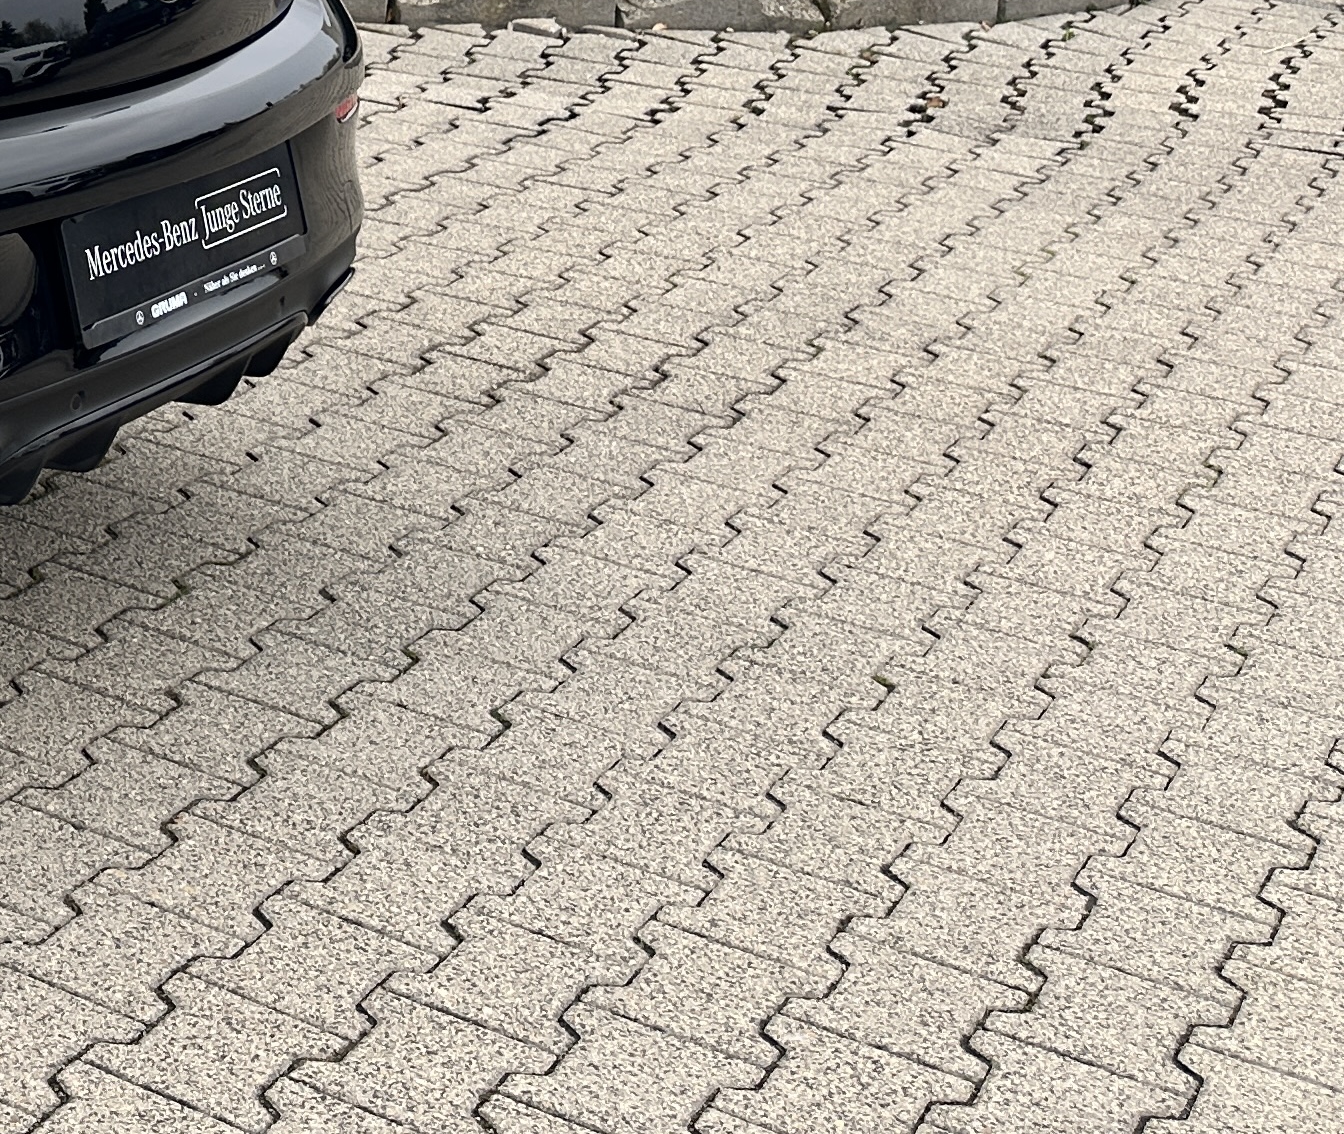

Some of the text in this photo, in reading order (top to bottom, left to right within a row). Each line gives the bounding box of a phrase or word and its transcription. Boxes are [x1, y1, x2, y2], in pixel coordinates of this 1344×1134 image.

[84, 184, 282, 281] Mercedes-Benz Junge Sterne
[151, 291, 188, 319] GRUMA
